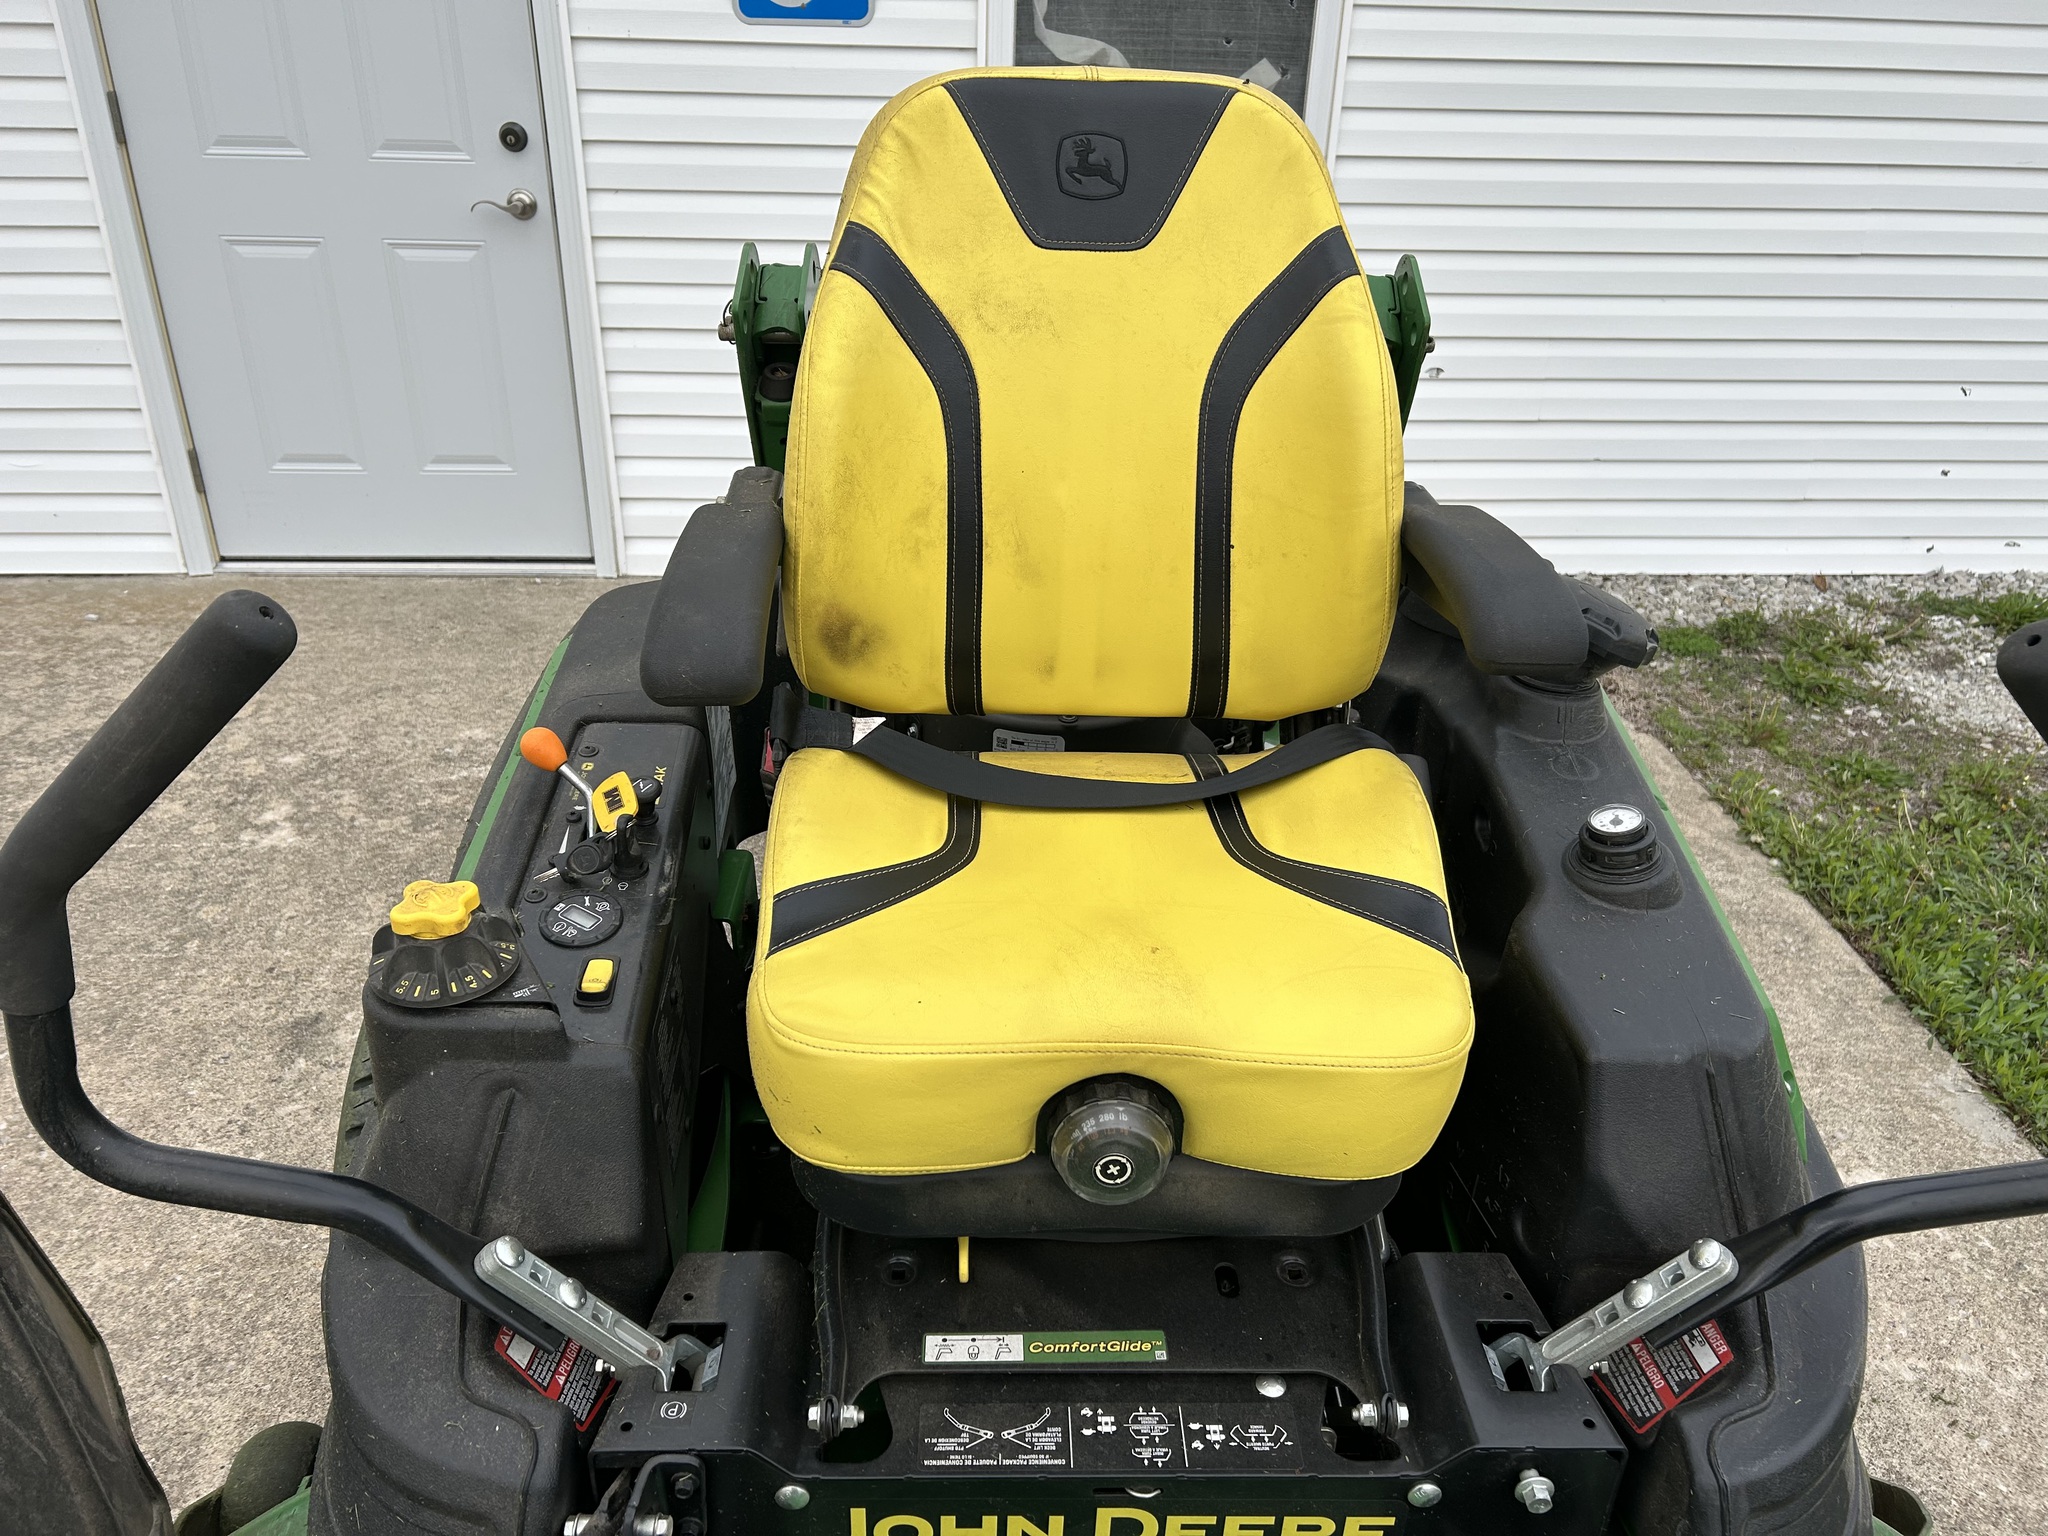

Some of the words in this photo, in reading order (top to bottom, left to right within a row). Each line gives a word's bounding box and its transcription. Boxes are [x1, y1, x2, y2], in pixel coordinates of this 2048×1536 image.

[395, 980, 409, 994] 5.5
[464, 975, 478, 988] 4.5
[1701, 1323, 1727, 1354] ANGER
[1633, 1348, 1666, 1389] PELIGRO
